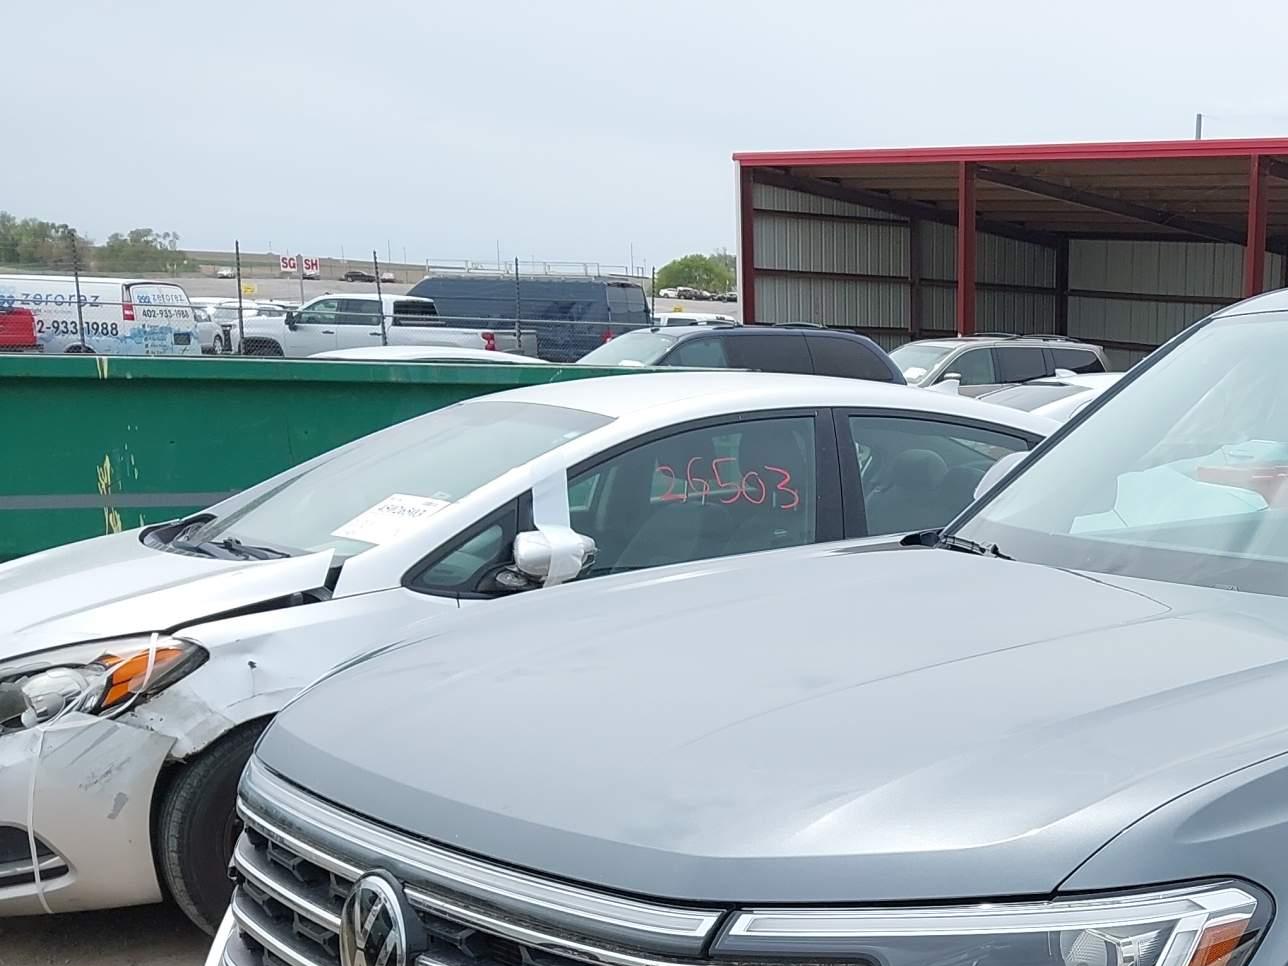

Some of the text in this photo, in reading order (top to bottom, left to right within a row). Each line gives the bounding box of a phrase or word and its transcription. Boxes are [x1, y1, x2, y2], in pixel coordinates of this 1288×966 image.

[281, 256, 297, 269] SG
[303, 258, 318, 271] SH
[20, 293, 101, 307] zerorez
[655, 456, 800, 509] 26503
